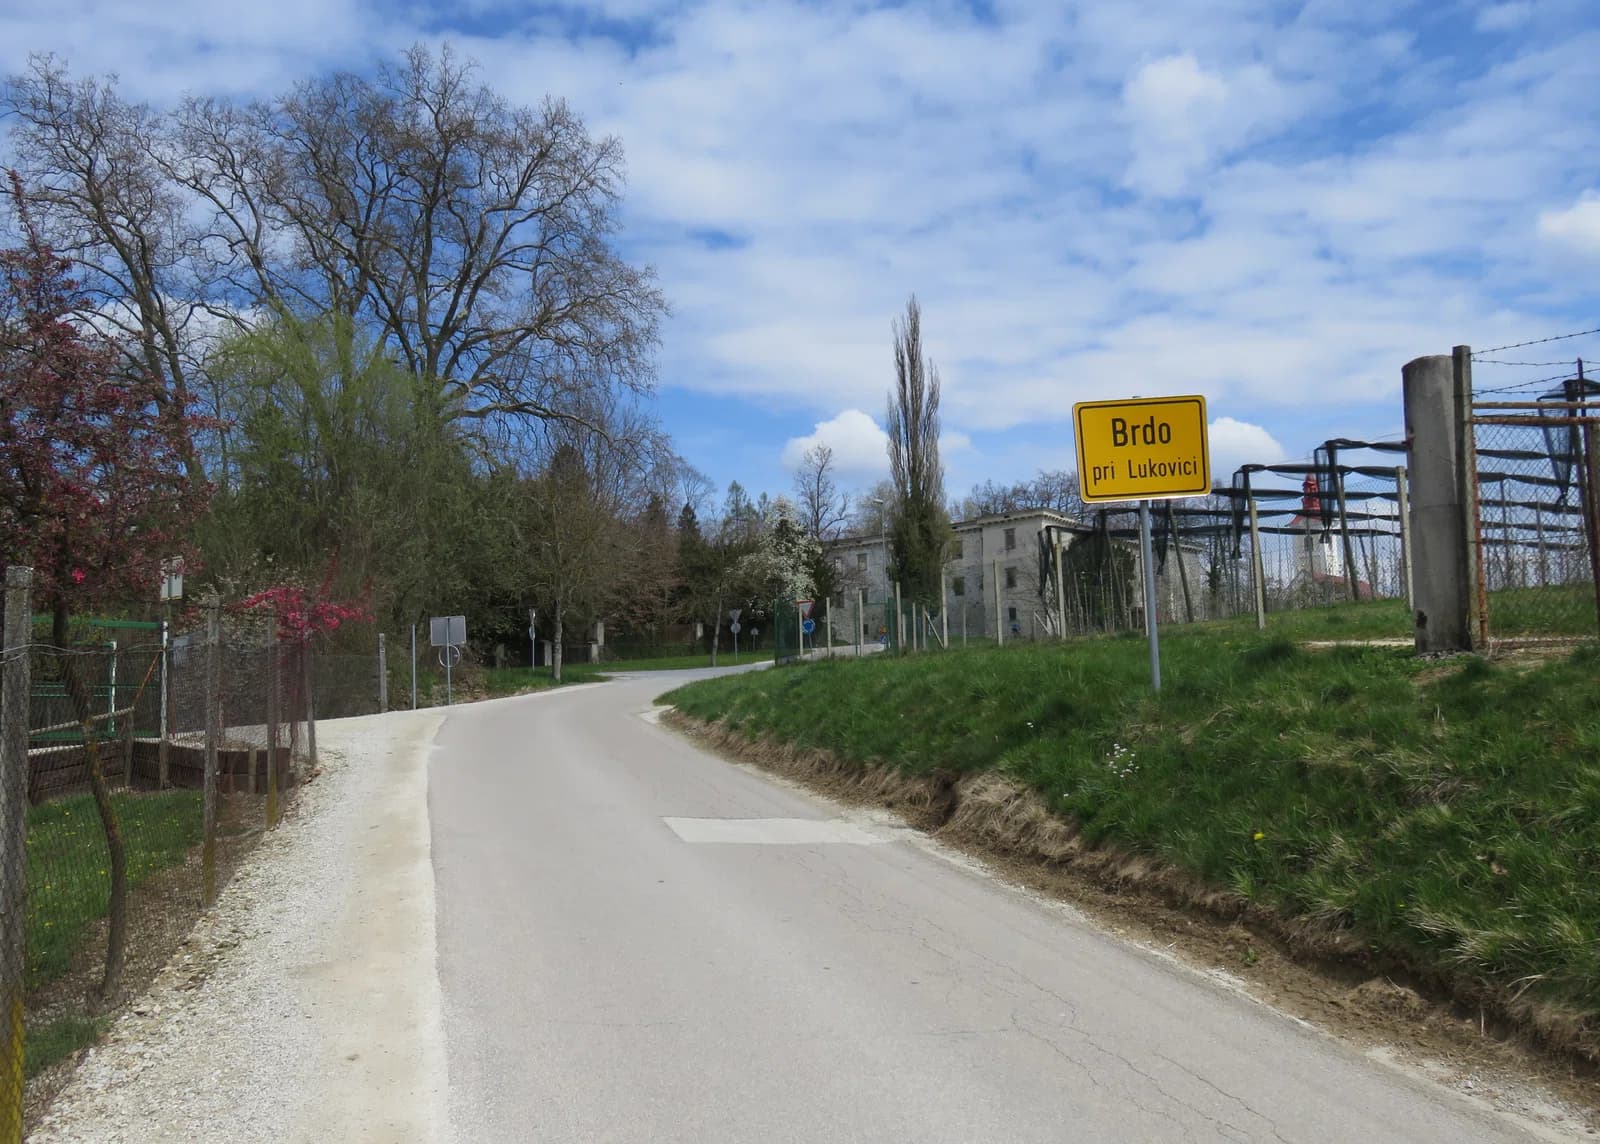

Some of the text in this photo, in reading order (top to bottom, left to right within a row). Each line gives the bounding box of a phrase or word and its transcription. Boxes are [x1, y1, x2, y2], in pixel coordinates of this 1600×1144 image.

[1112, 415, 1171, 447] Brdo
[1092, 456, 1198, 486] pri Lukovici
